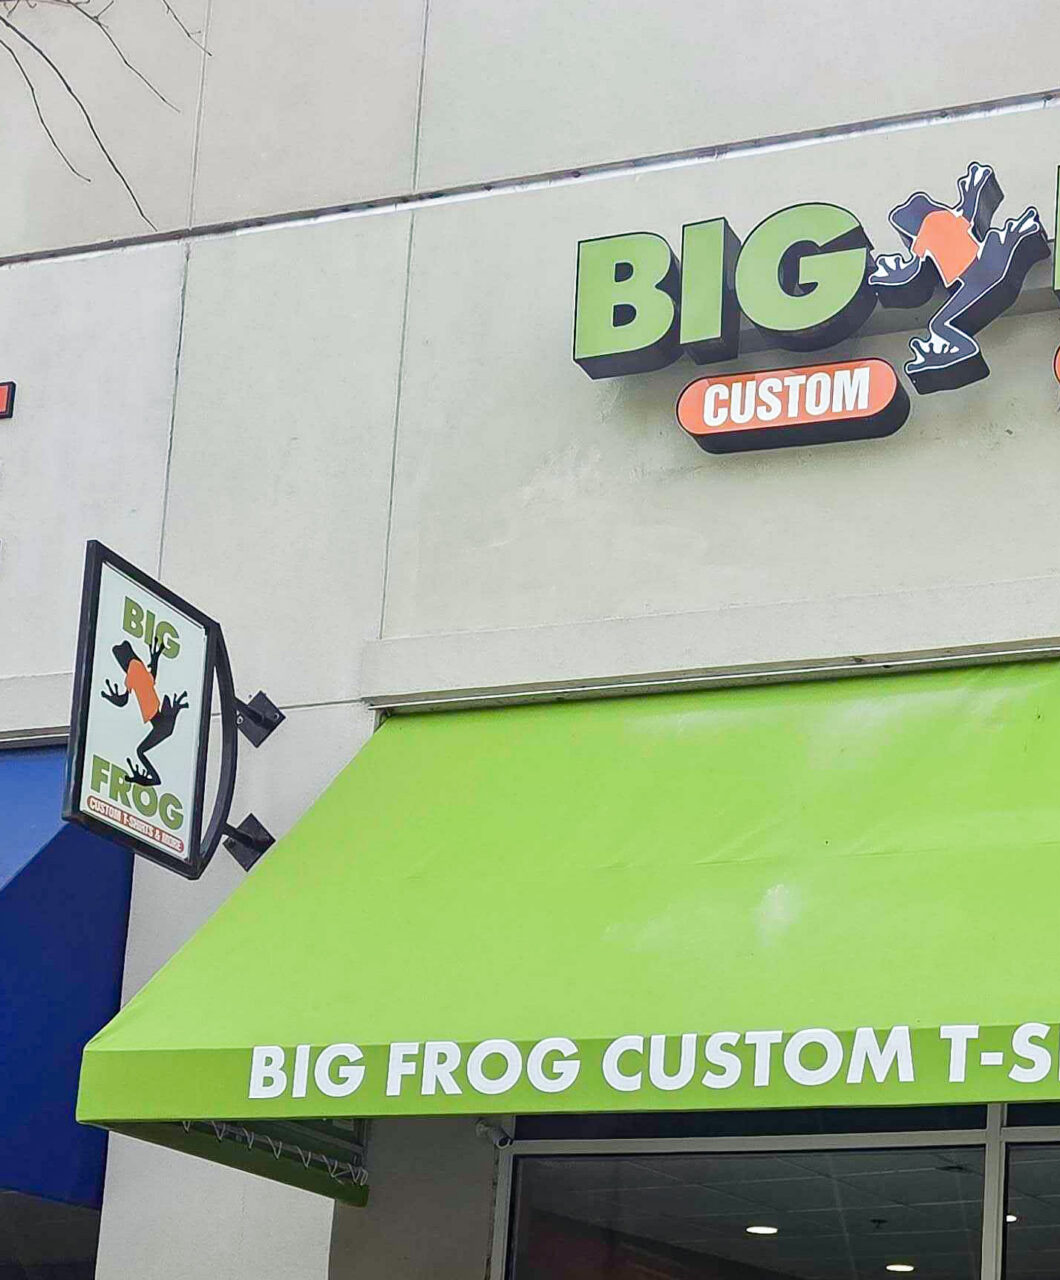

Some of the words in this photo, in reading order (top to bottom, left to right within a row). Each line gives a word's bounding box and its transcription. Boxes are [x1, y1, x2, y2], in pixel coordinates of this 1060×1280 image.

[573, 202, 872, 362] BIG
[702, 366, 871, 427] CUSTOM
[122, 595, 181, 660] BIG
[89, 797, 121, 822] CUSTOM
[122, 812, 154, 837] T-SHIRTS
[154, 829, 161, 841] &
[90, 754, 184, 831] FROG
[248, 1043, 366, 1099] BIG
[385, 1037, 582, 1097] FROG
[601, 1025, 916, 1092] CUSTOM
